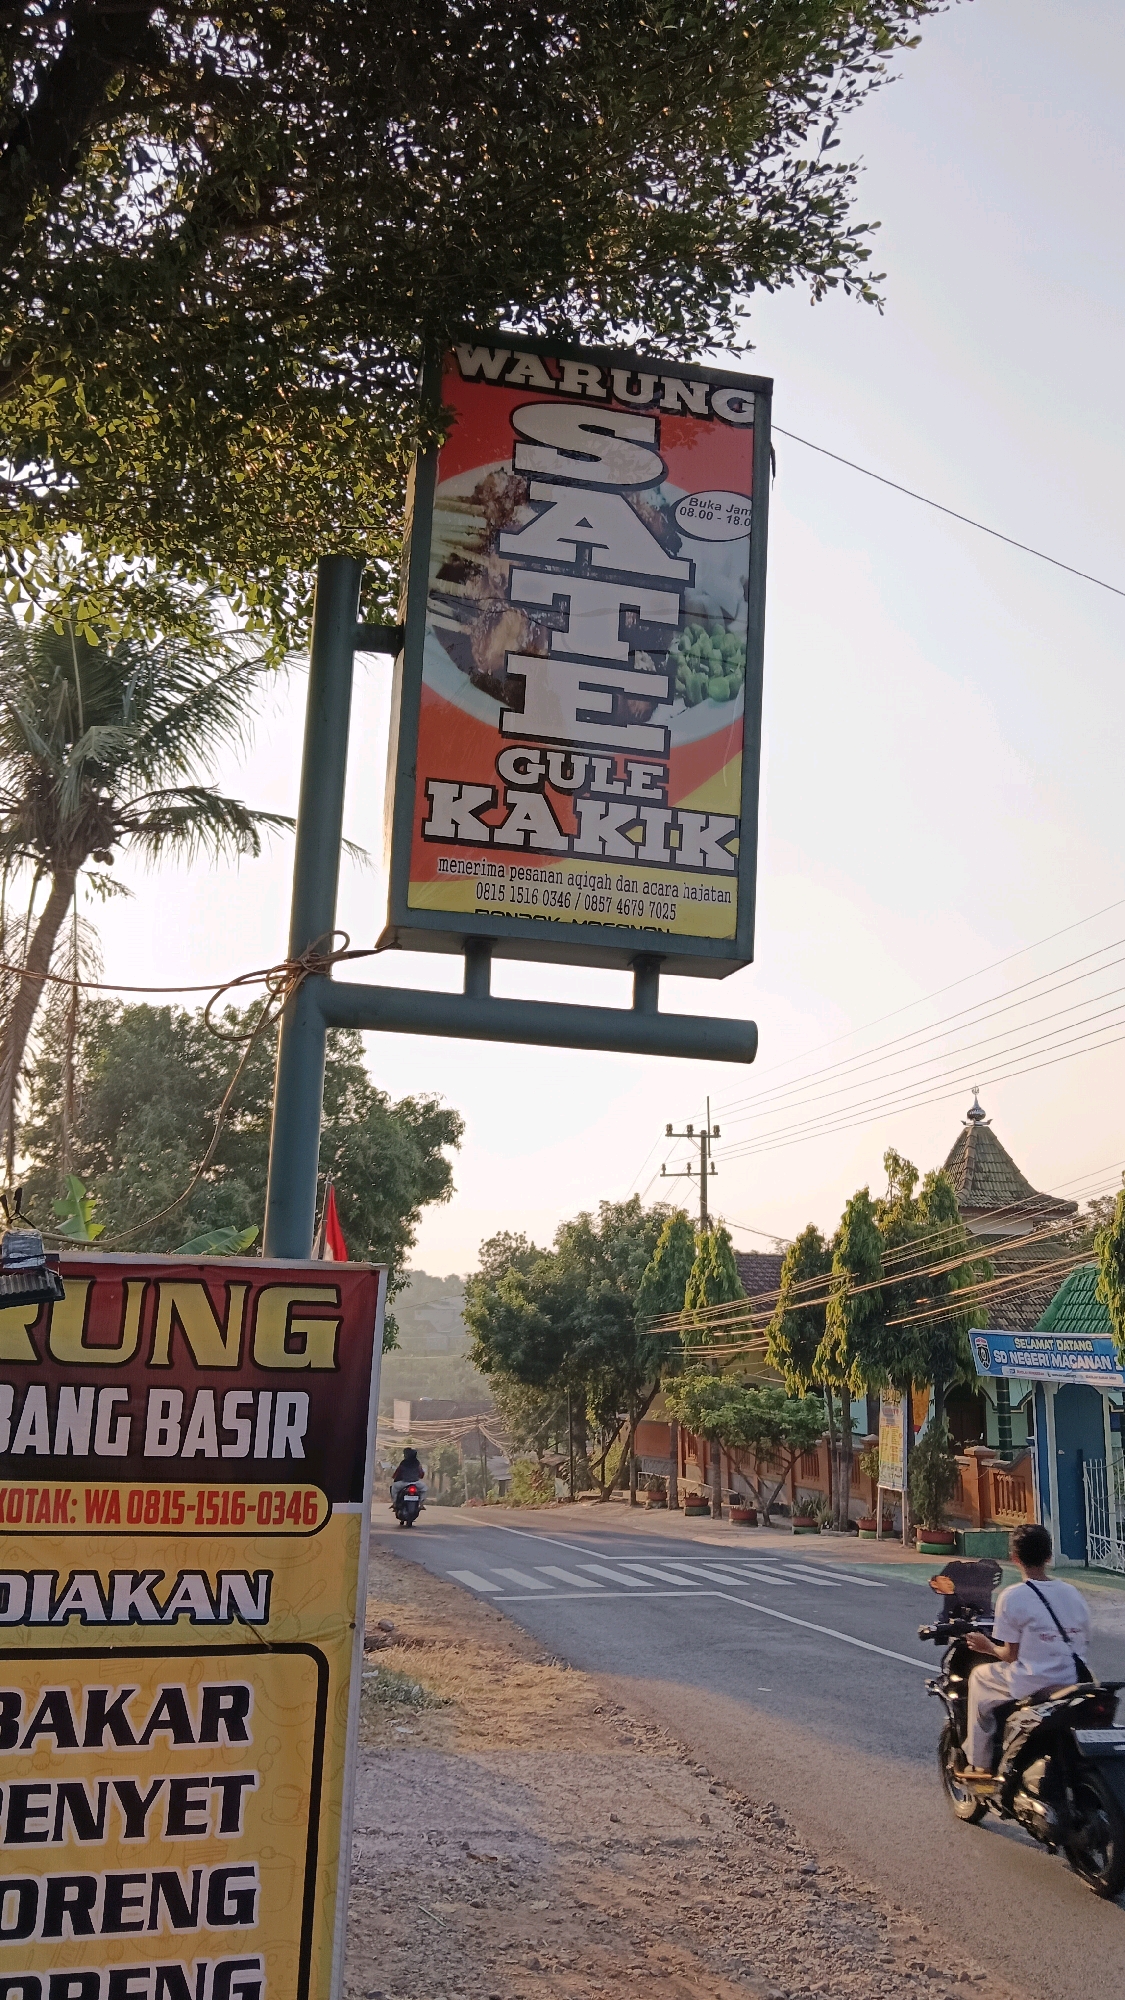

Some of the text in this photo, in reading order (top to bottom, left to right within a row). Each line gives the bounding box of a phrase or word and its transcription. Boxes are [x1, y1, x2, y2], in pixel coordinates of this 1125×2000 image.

[452, 342, 755, 423] WARUNG
[679, 506, 714, 520] 08.00
[688, 497, 752, 517] Buka Jam
[499, 402, 692, 753] SATE
[498, 748, 665, 799] GULE
[424, 780, 738, 871] KAKIK
[438, 858, 732, 903] menerima pesanan aqiqah dan acara hajatan
[476, 882, 677, 920] 0815 1516 0346 / 0857 4679 7025
[994, 1349, 1008, 1364] SD
[1009, 1351, 1051, 1367] NEGERI
[1051, 1353, 1113, 1371] MACANAN
[1014, 1337, 1094, 1352] SELAMAT DATANG
[144, 1388, 310, 1458] BASIR
[85, 1489, 121, 1525] WA
[126, 1489, 318, 1526] 0815-1516-0346
[0, 1774, 256, 1844] ENYET
